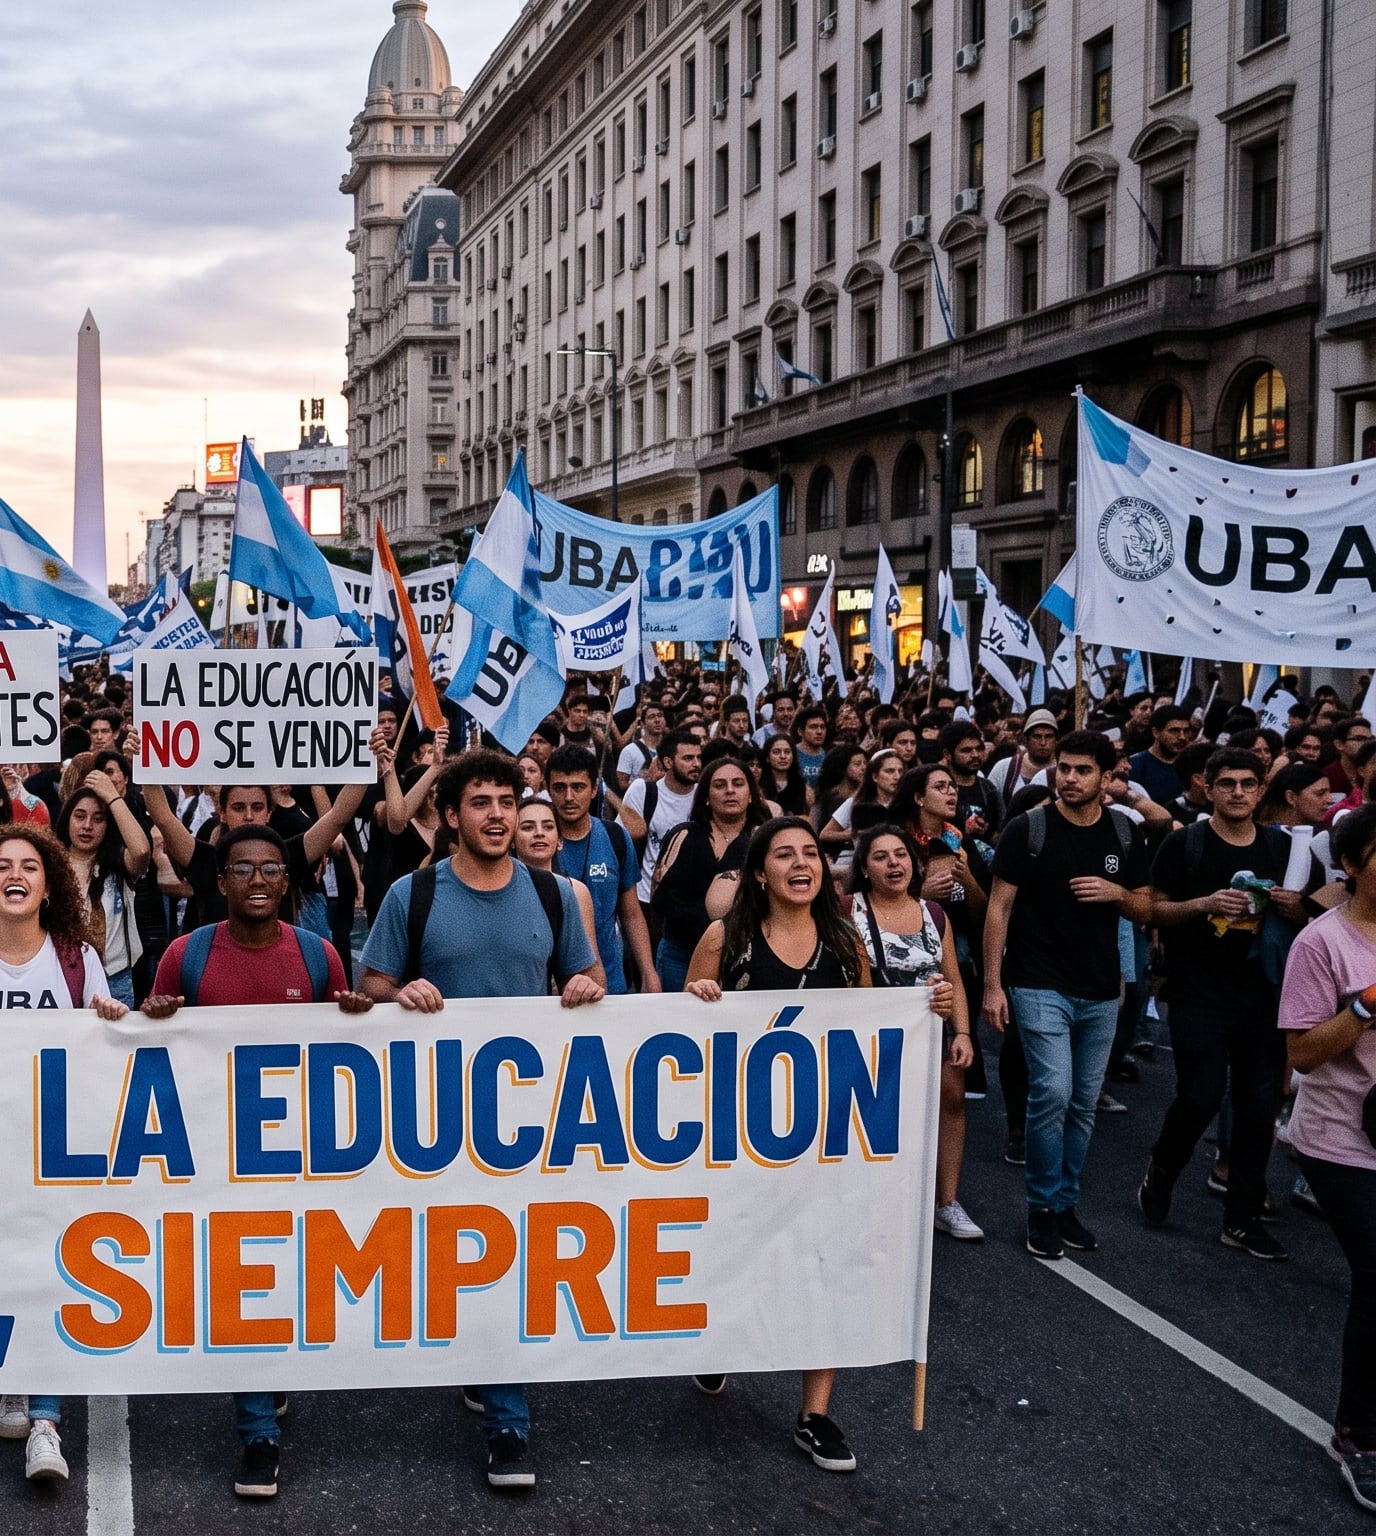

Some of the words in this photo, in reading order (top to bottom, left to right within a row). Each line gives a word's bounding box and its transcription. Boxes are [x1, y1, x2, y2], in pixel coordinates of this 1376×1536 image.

[1184, 514, 1376, 595] UBA
[140, 662, 186, 708] LA
[198, 650, 374, 708] EDUCACIÓN
[141, 720, 200, 769] NO
[213, 719, 255, 768] SE
[268, 719, 372, 768] VENDE
[34, 1045, 196, 1185] LA
[227, 1005, 905, 1184] EDUCACIÓN
[54, 1196, 709, 1357] SIEMPRE
